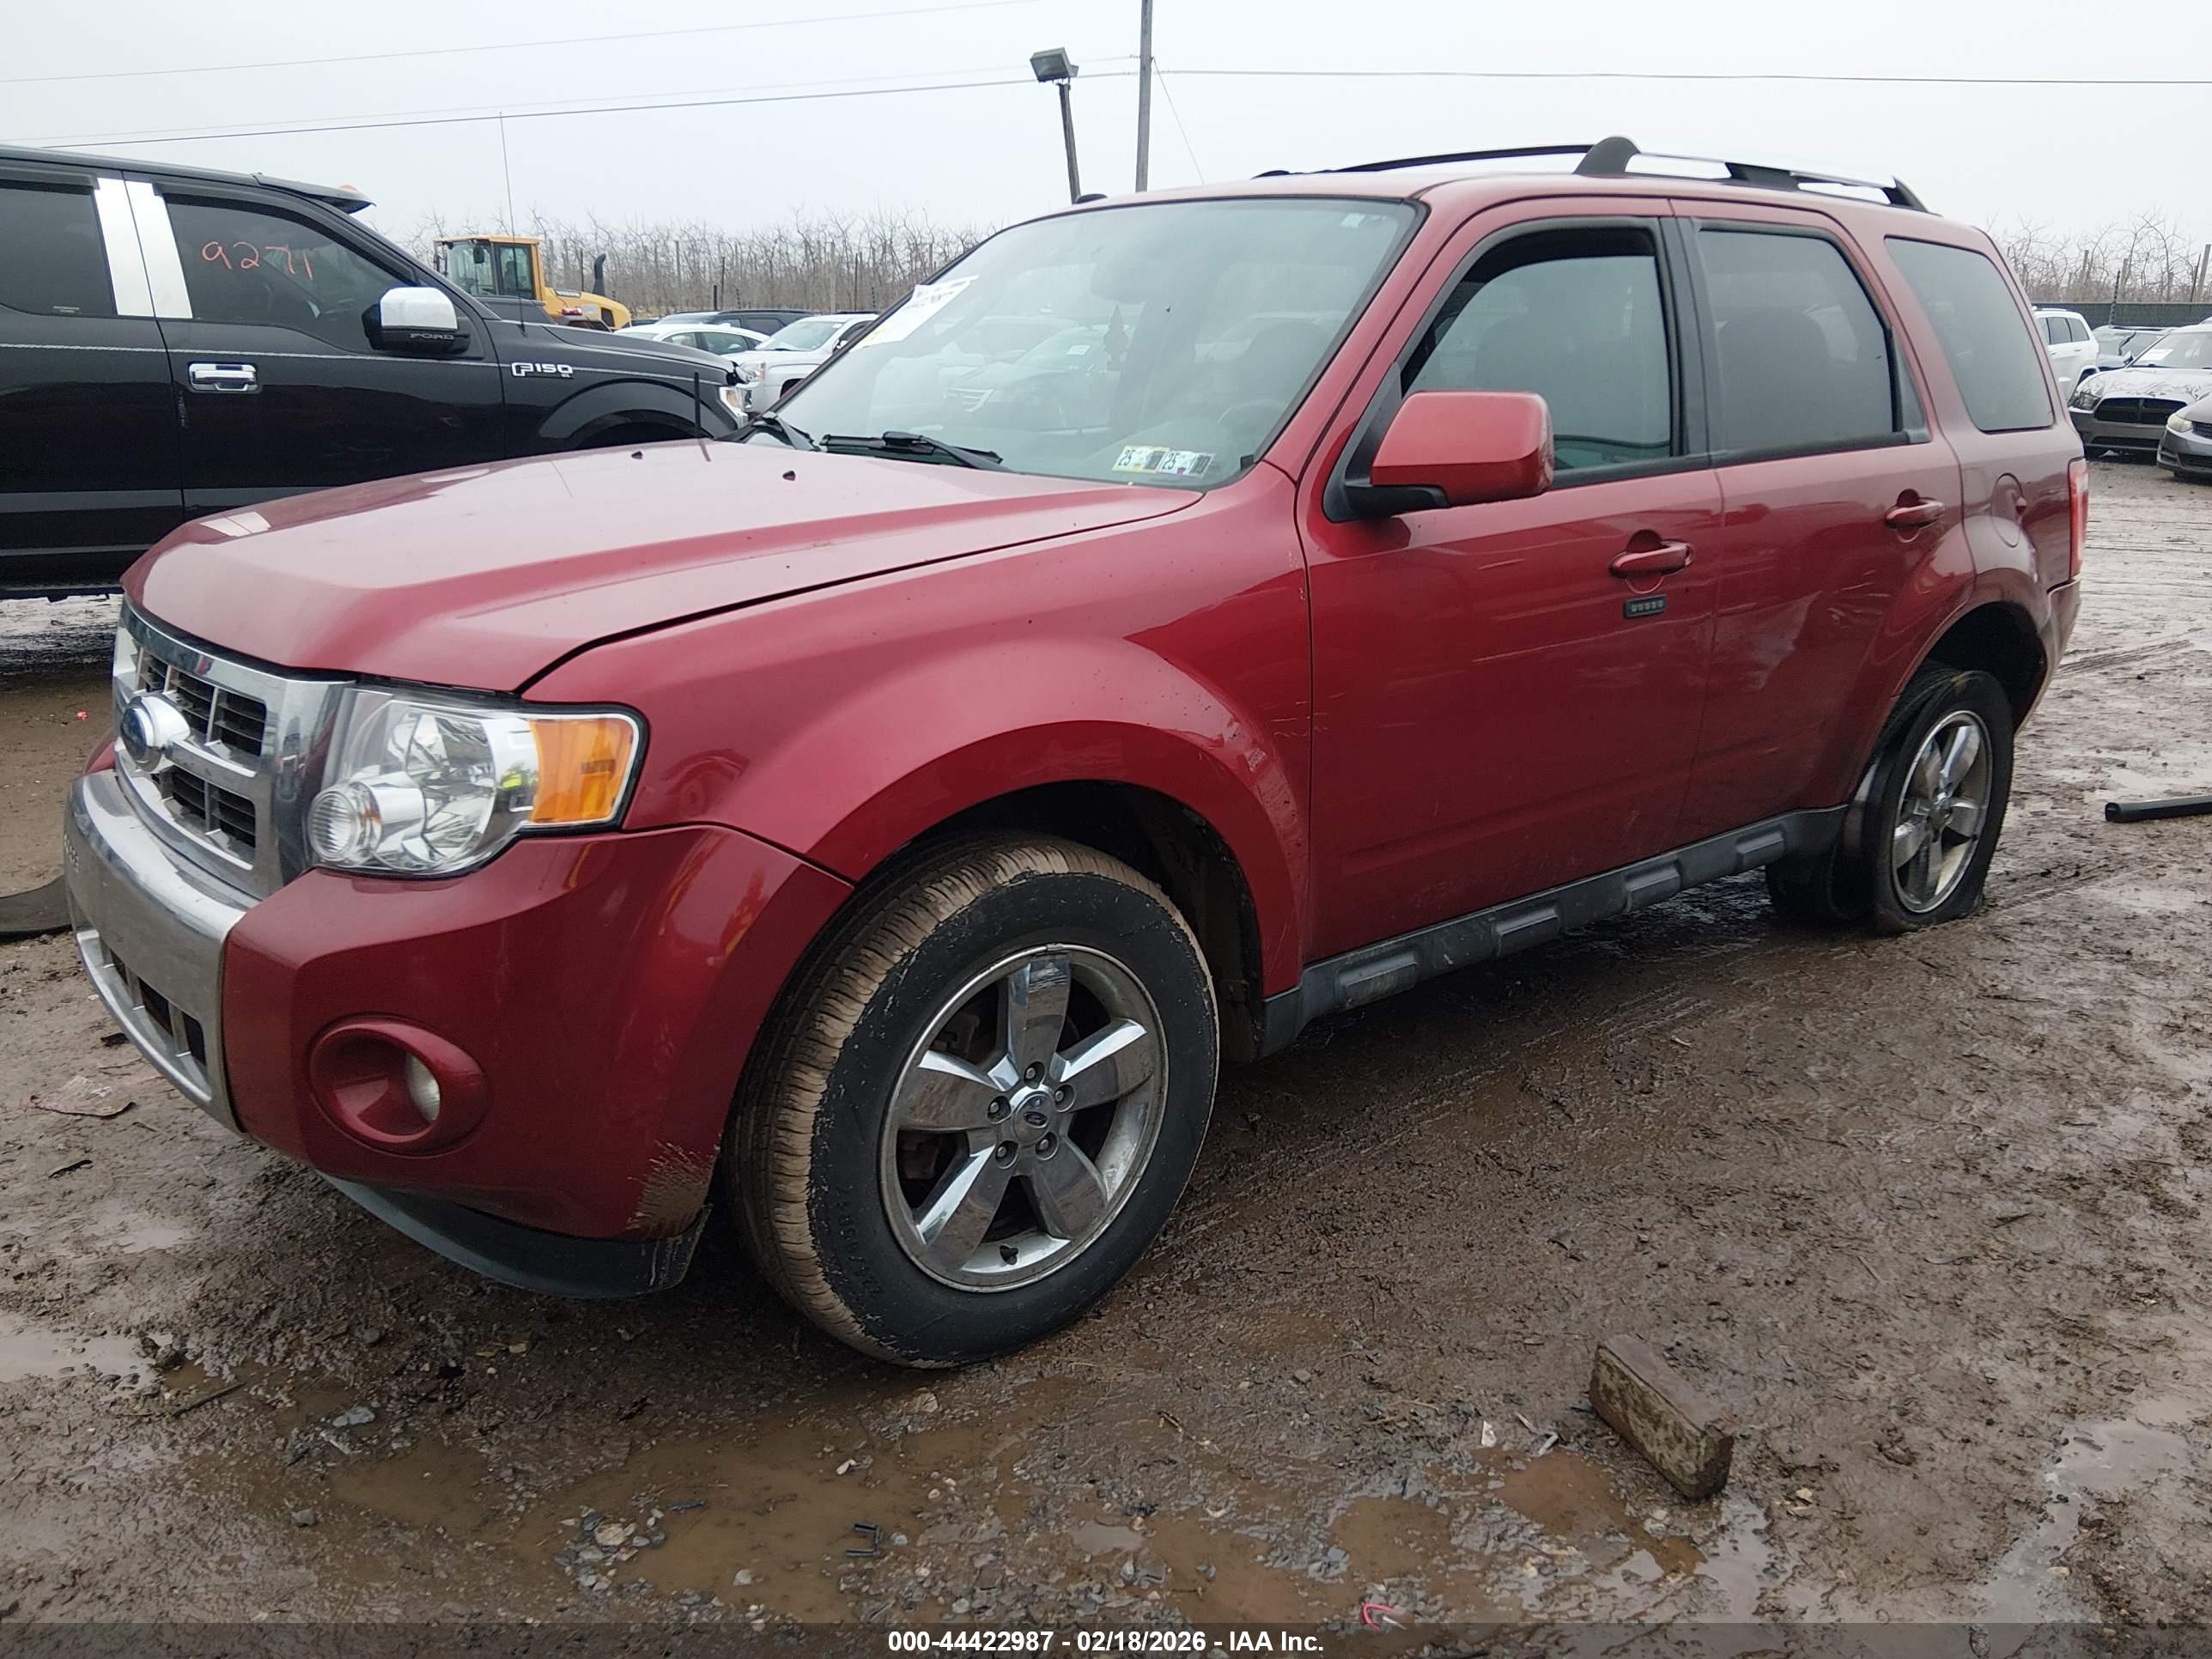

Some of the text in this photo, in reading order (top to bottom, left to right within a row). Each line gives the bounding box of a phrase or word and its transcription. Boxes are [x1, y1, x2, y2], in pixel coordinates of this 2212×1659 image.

[201, 240, 313, 281] 9271
[410, 332, 454, 341] FORD
[1117, 448, 1137, 467] 25
[1162, 452, 1181, 471] 25
